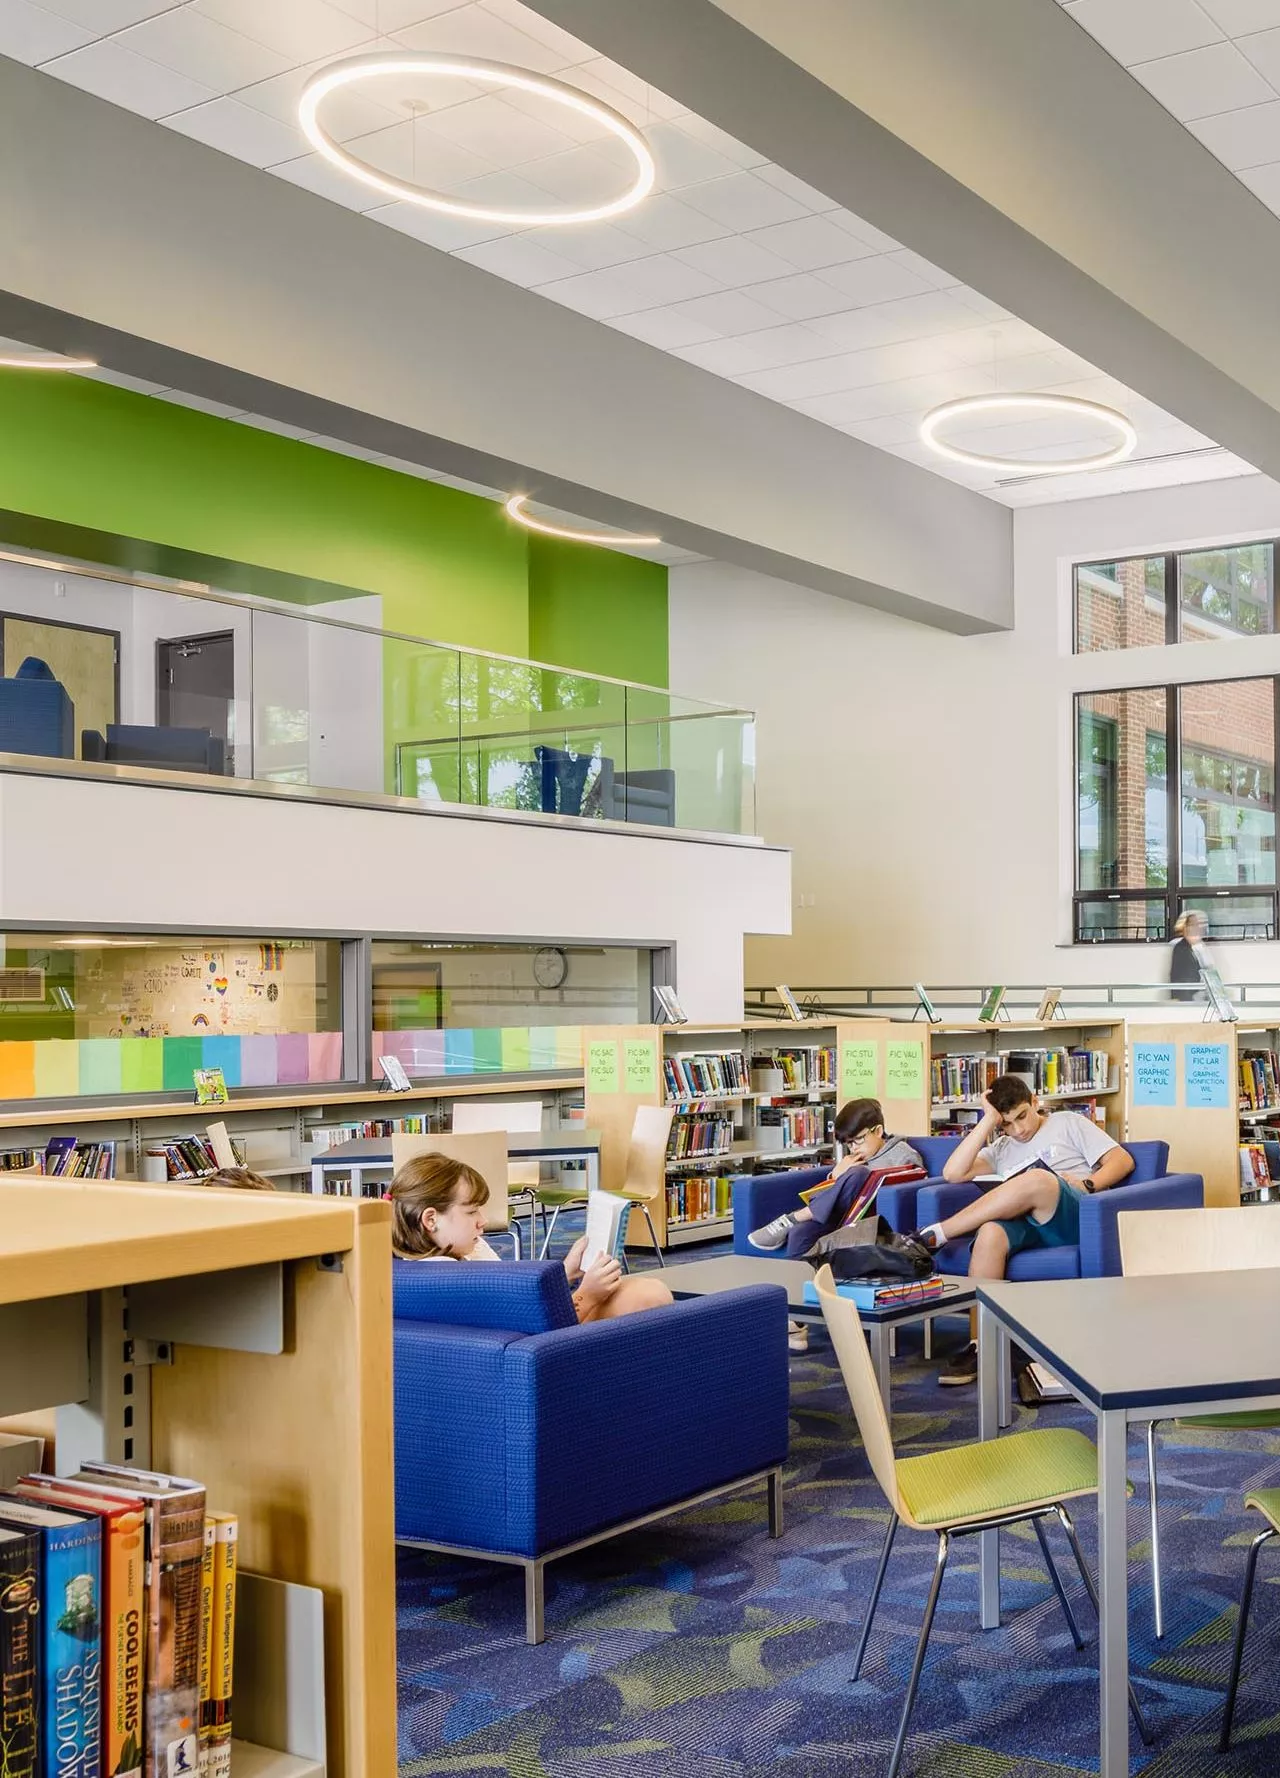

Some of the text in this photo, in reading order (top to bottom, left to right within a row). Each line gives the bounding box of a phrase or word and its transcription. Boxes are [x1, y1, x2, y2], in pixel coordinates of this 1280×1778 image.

[590, 1048, 601, 1057] FIC
[628, 1048, 638, 1057] FIC
[846, 1050, 873, 1058] FIC STU
[889, 1050, 917, 1059] FIC VAU
[1190, 1047, 1221, 1055] GRAPHIC
[1138, 1053, 1170, 1062] FIC YAN
[1193, 1057, 1219, 1065] FIC LAR
[590, 1066, 601, 1074] FIC
[628, 1066, 638, 1074] FIC
[845, 1069, 873, 1077] FIC VAN
[888, 1069, 901, 1078] FIC
[1138, 1068, 1170, 1076] GRAPHIC
[1139, 1077, 1168, 1085] FIC KUL
[202, 1586, 212, 1616] Charlie
[224, 1583, 233, 1612] Charlie
[200, 1617, 211, 1654] Bumpers
[223, 1612, 233, 1650] Bumpers
[12, 1618, 28, 1664] THE
[117, 1654, 125, 1694] ADVENTURES
[125, 1609, 139, 1732] COOL BEANS
[80, 1661, 100, 1776] SKINFUL
